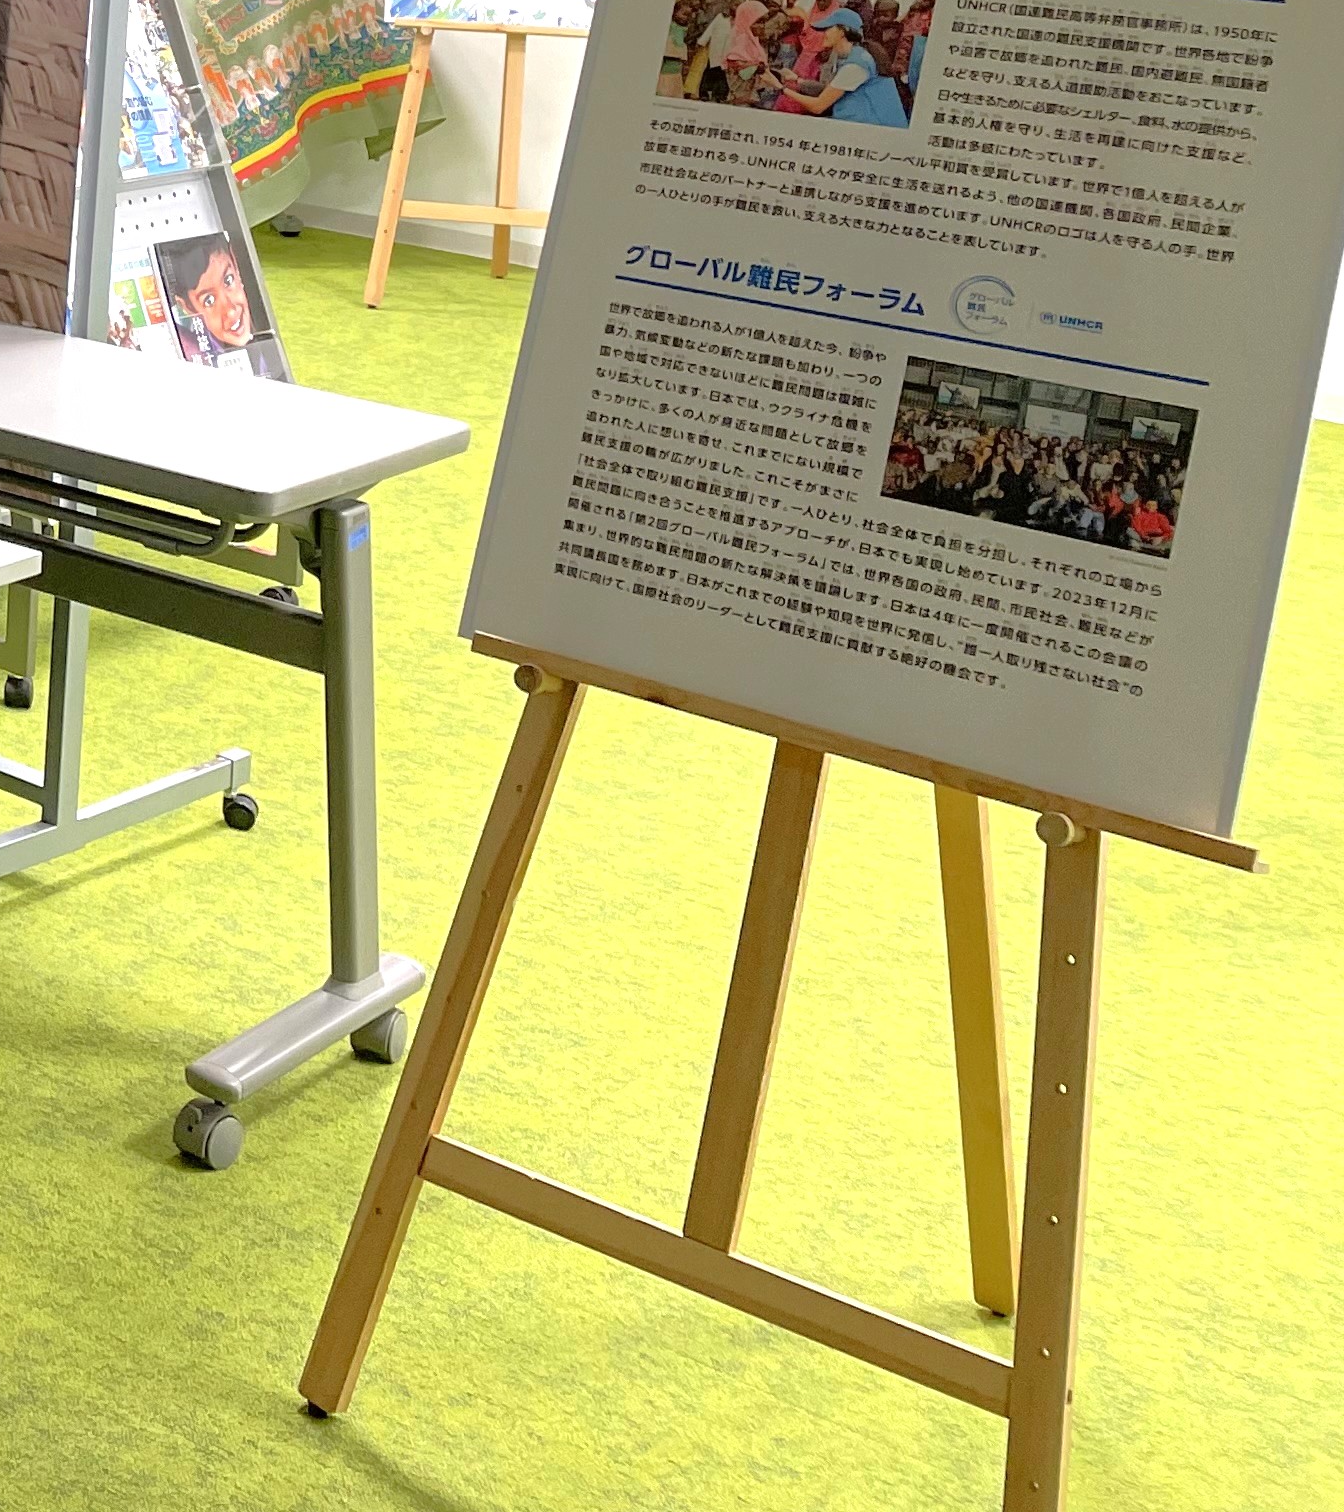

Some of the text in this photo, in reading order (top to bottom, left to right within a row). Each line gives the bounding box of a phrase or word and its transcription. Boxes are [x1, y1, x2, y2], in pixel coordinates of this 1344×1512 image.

[625, 244, 927, 317] グローバル難民フォーラム
[1059, 315, 1104, 330] UNHCR
